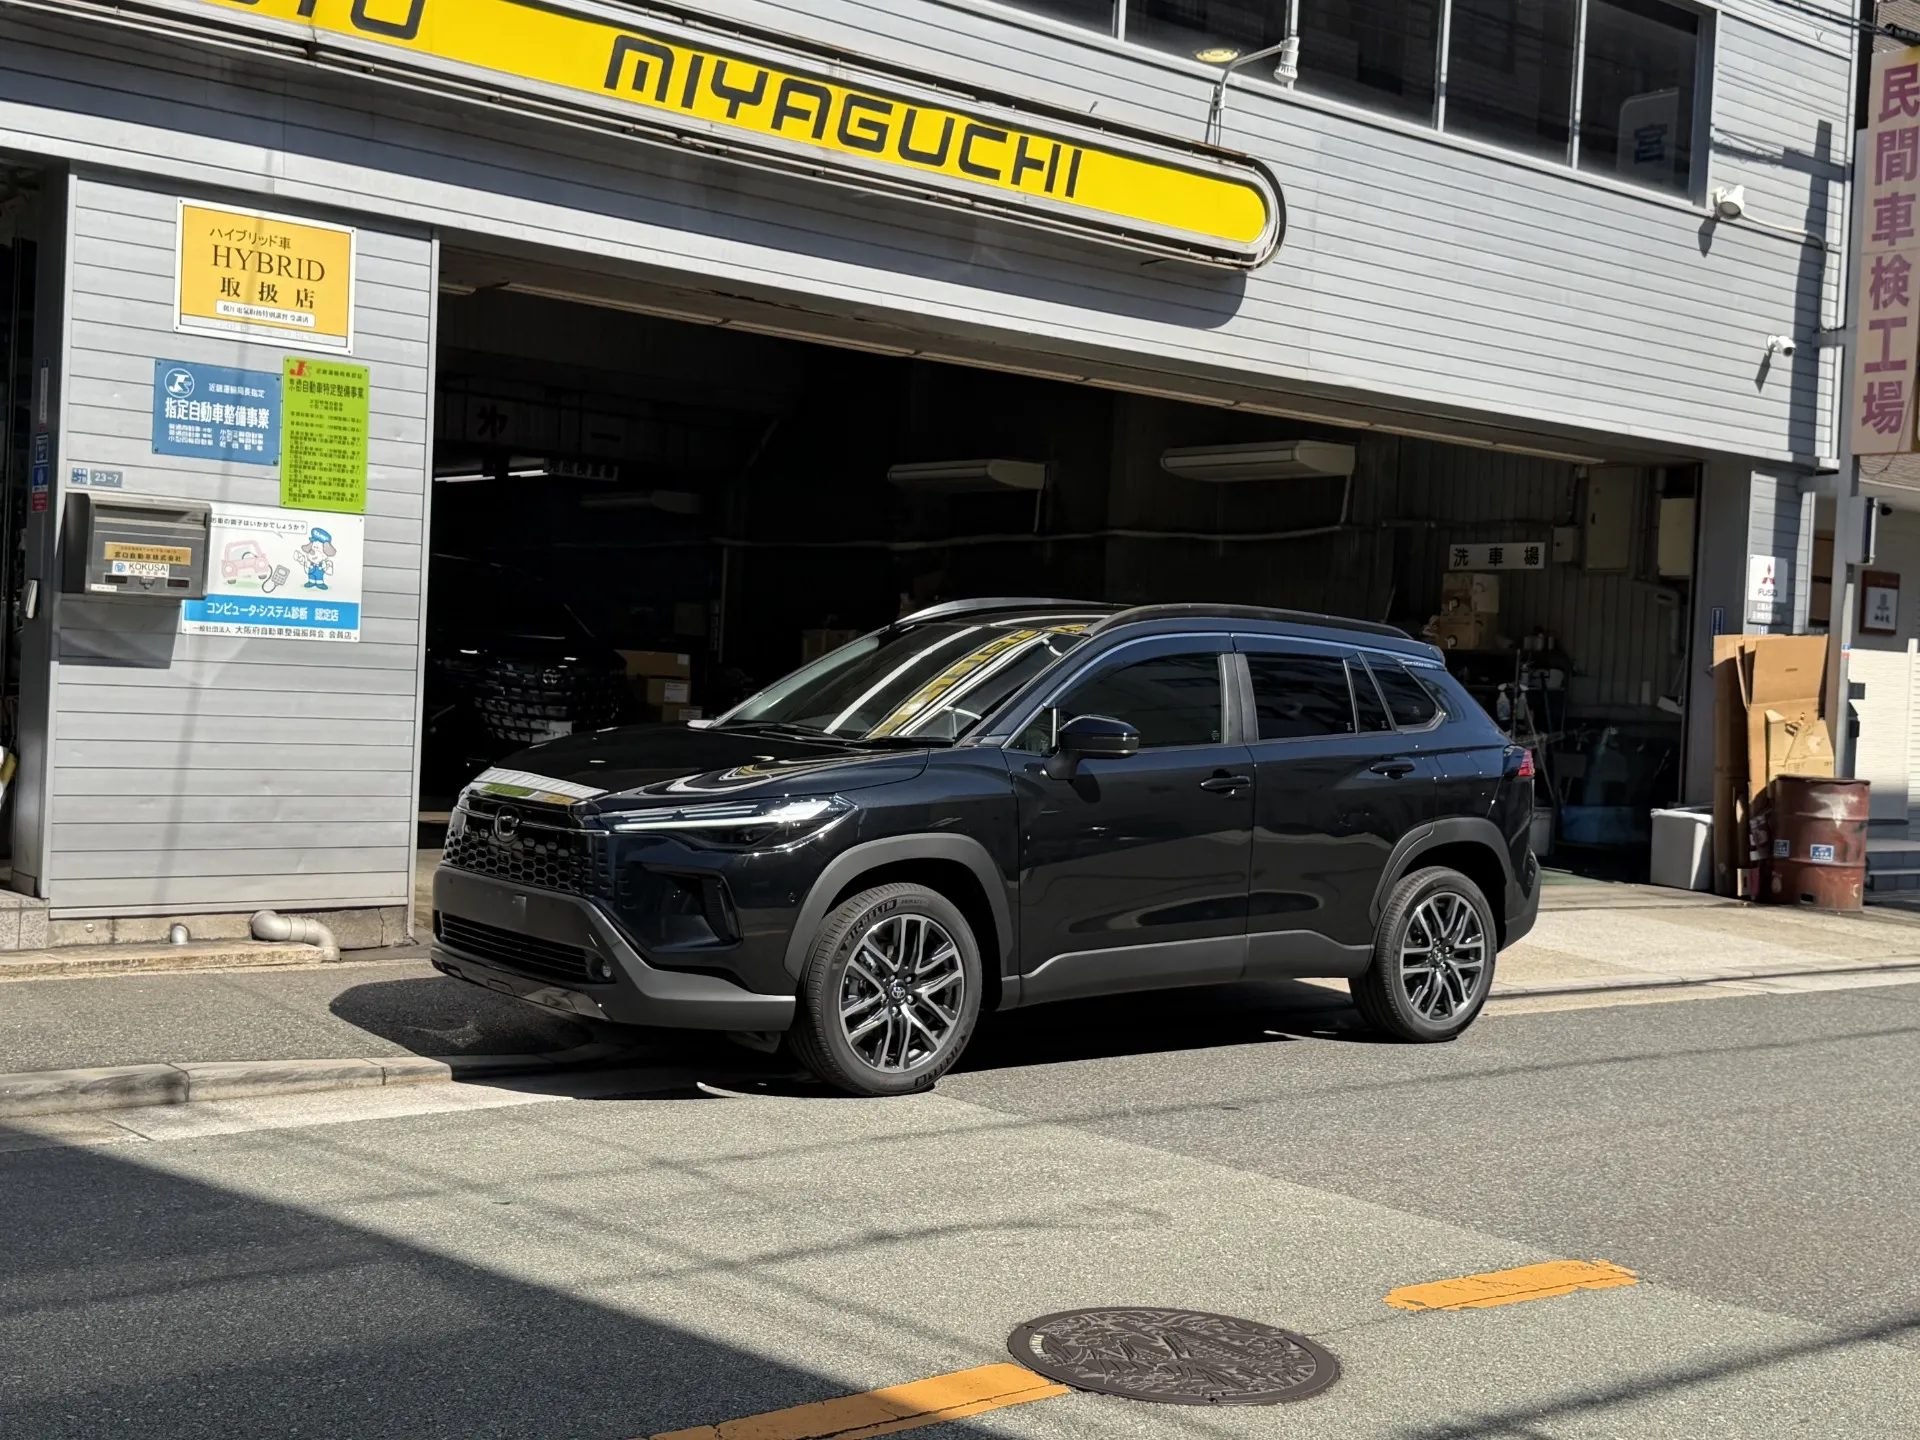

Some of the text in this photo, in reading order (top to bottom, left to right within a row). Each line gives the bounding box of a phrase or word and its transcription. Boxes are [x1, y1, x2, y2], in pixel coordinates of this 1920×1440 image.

[604, 34, 1082, 198] MIYAGUCHI
[210, 228, 292, 250] ハイブリッド車
[1861, 63, 1920, 435] 民間車検工場
[211, 244, 325, 282] HYBRID
[220, 276, 315, 309] 取扱店
[165, 397, 270, 430] 指定自動車整備事業
[94, 472, 119, 484] 23-7
[128, 562, 168, 572] KOKUSAI
[1453, 546, 1540, 568] 洗車場
[328, 631, 352, 640] 会員店
